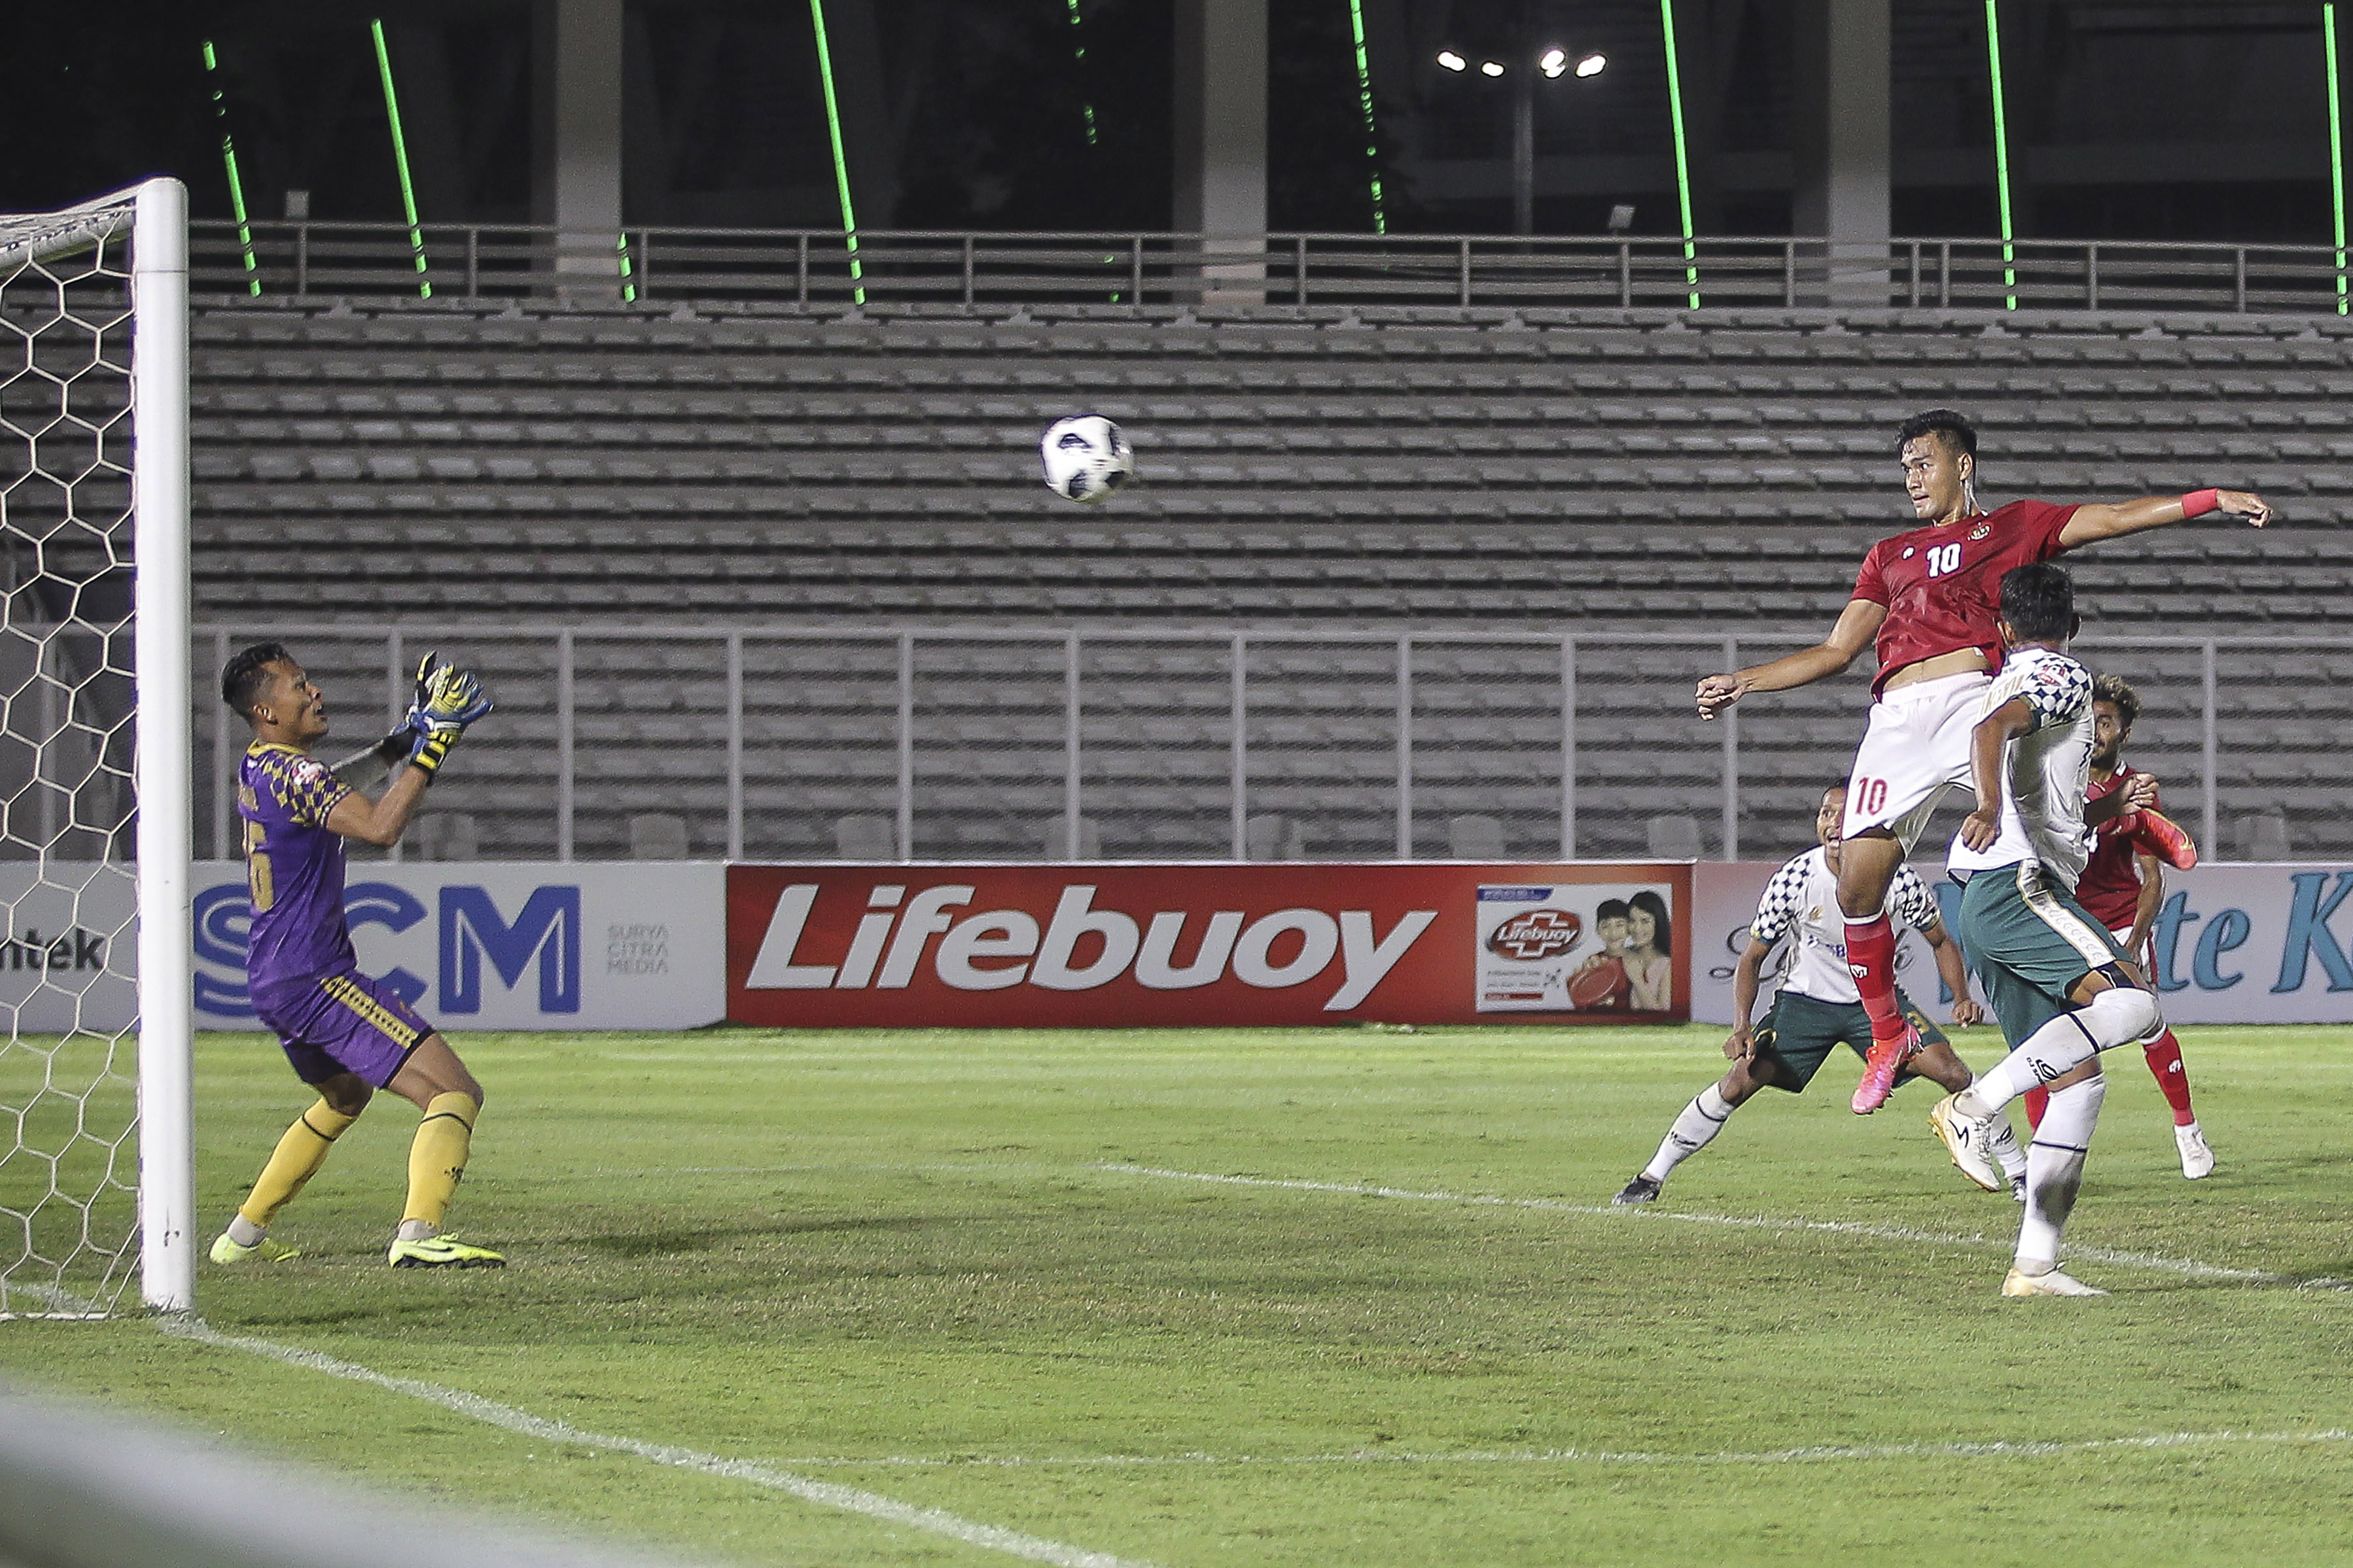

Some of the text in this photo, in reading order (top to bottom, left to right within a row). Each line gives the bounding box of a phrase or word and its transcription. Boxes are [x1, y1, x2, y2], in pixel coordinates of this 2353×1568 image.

[1926, 542, 1962, 578] 10
[1856, 776, 1888, 816] 10
[194, 883, 581, 1016] SCM
[746, 884, 1437, 1011] Lifebuoy
[1496, 926, 1578, 945] Lifebuoy
[2269, 872, 2353, 994] K
